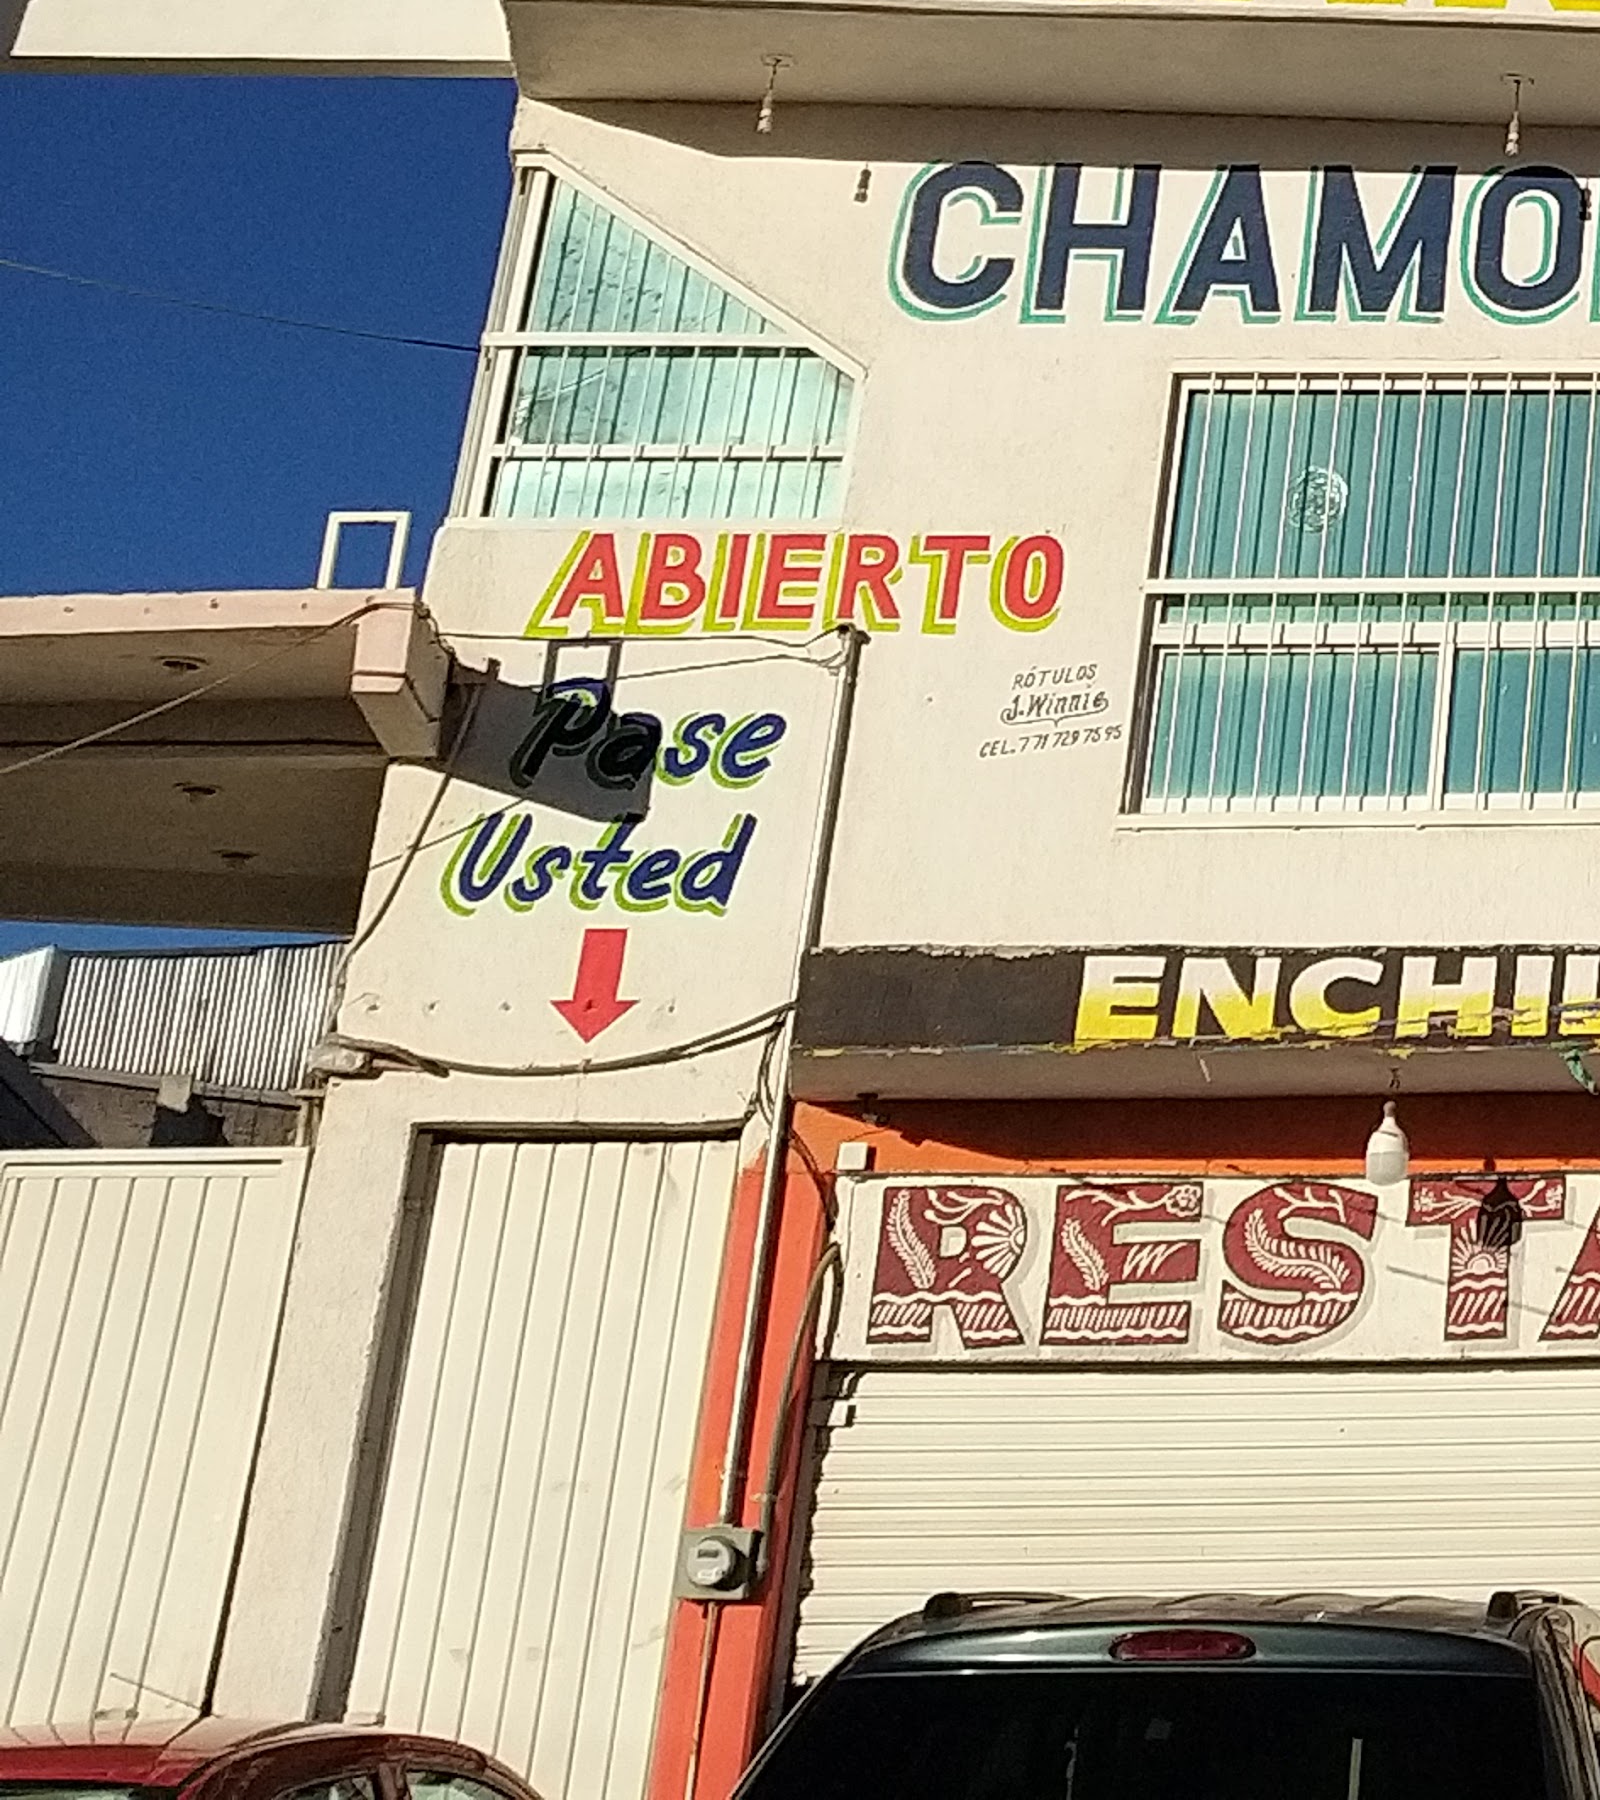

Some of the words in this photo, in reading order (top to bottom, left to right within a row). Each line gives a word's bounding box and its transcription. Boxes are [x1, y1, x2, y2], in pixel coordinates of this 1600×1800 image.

[523, 528, 1065, 637] ABIERTO
[1011, 663, 1098, 690] RÓTULOS
[509, 677, 789, 790] Pase
[439, 810, 760, 918] Usted
